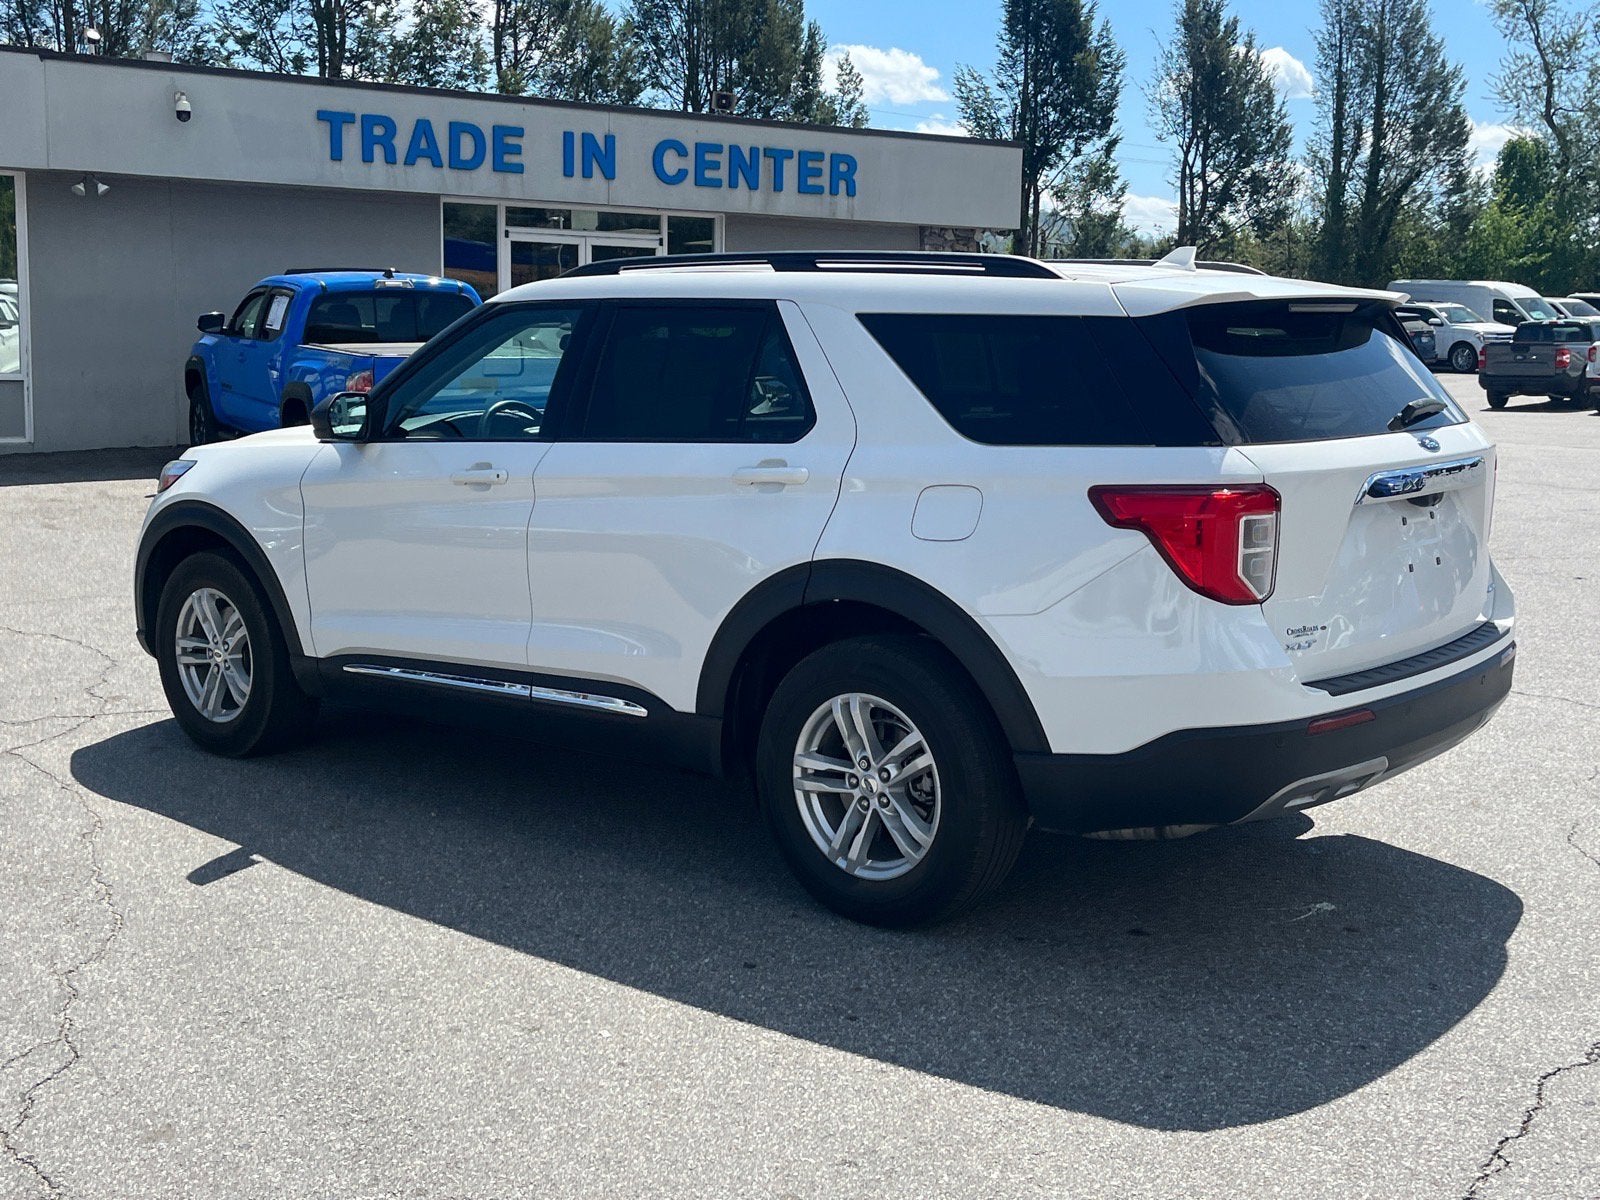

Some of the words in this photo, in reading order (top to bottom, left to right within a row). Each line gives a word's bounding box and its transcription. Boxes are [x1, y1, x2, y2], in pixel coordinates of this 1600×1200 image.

[316, 109, 525, 174] TRADE
[562, 131, 616, 180] IN
[652, 138, 858, 197] CENTER
